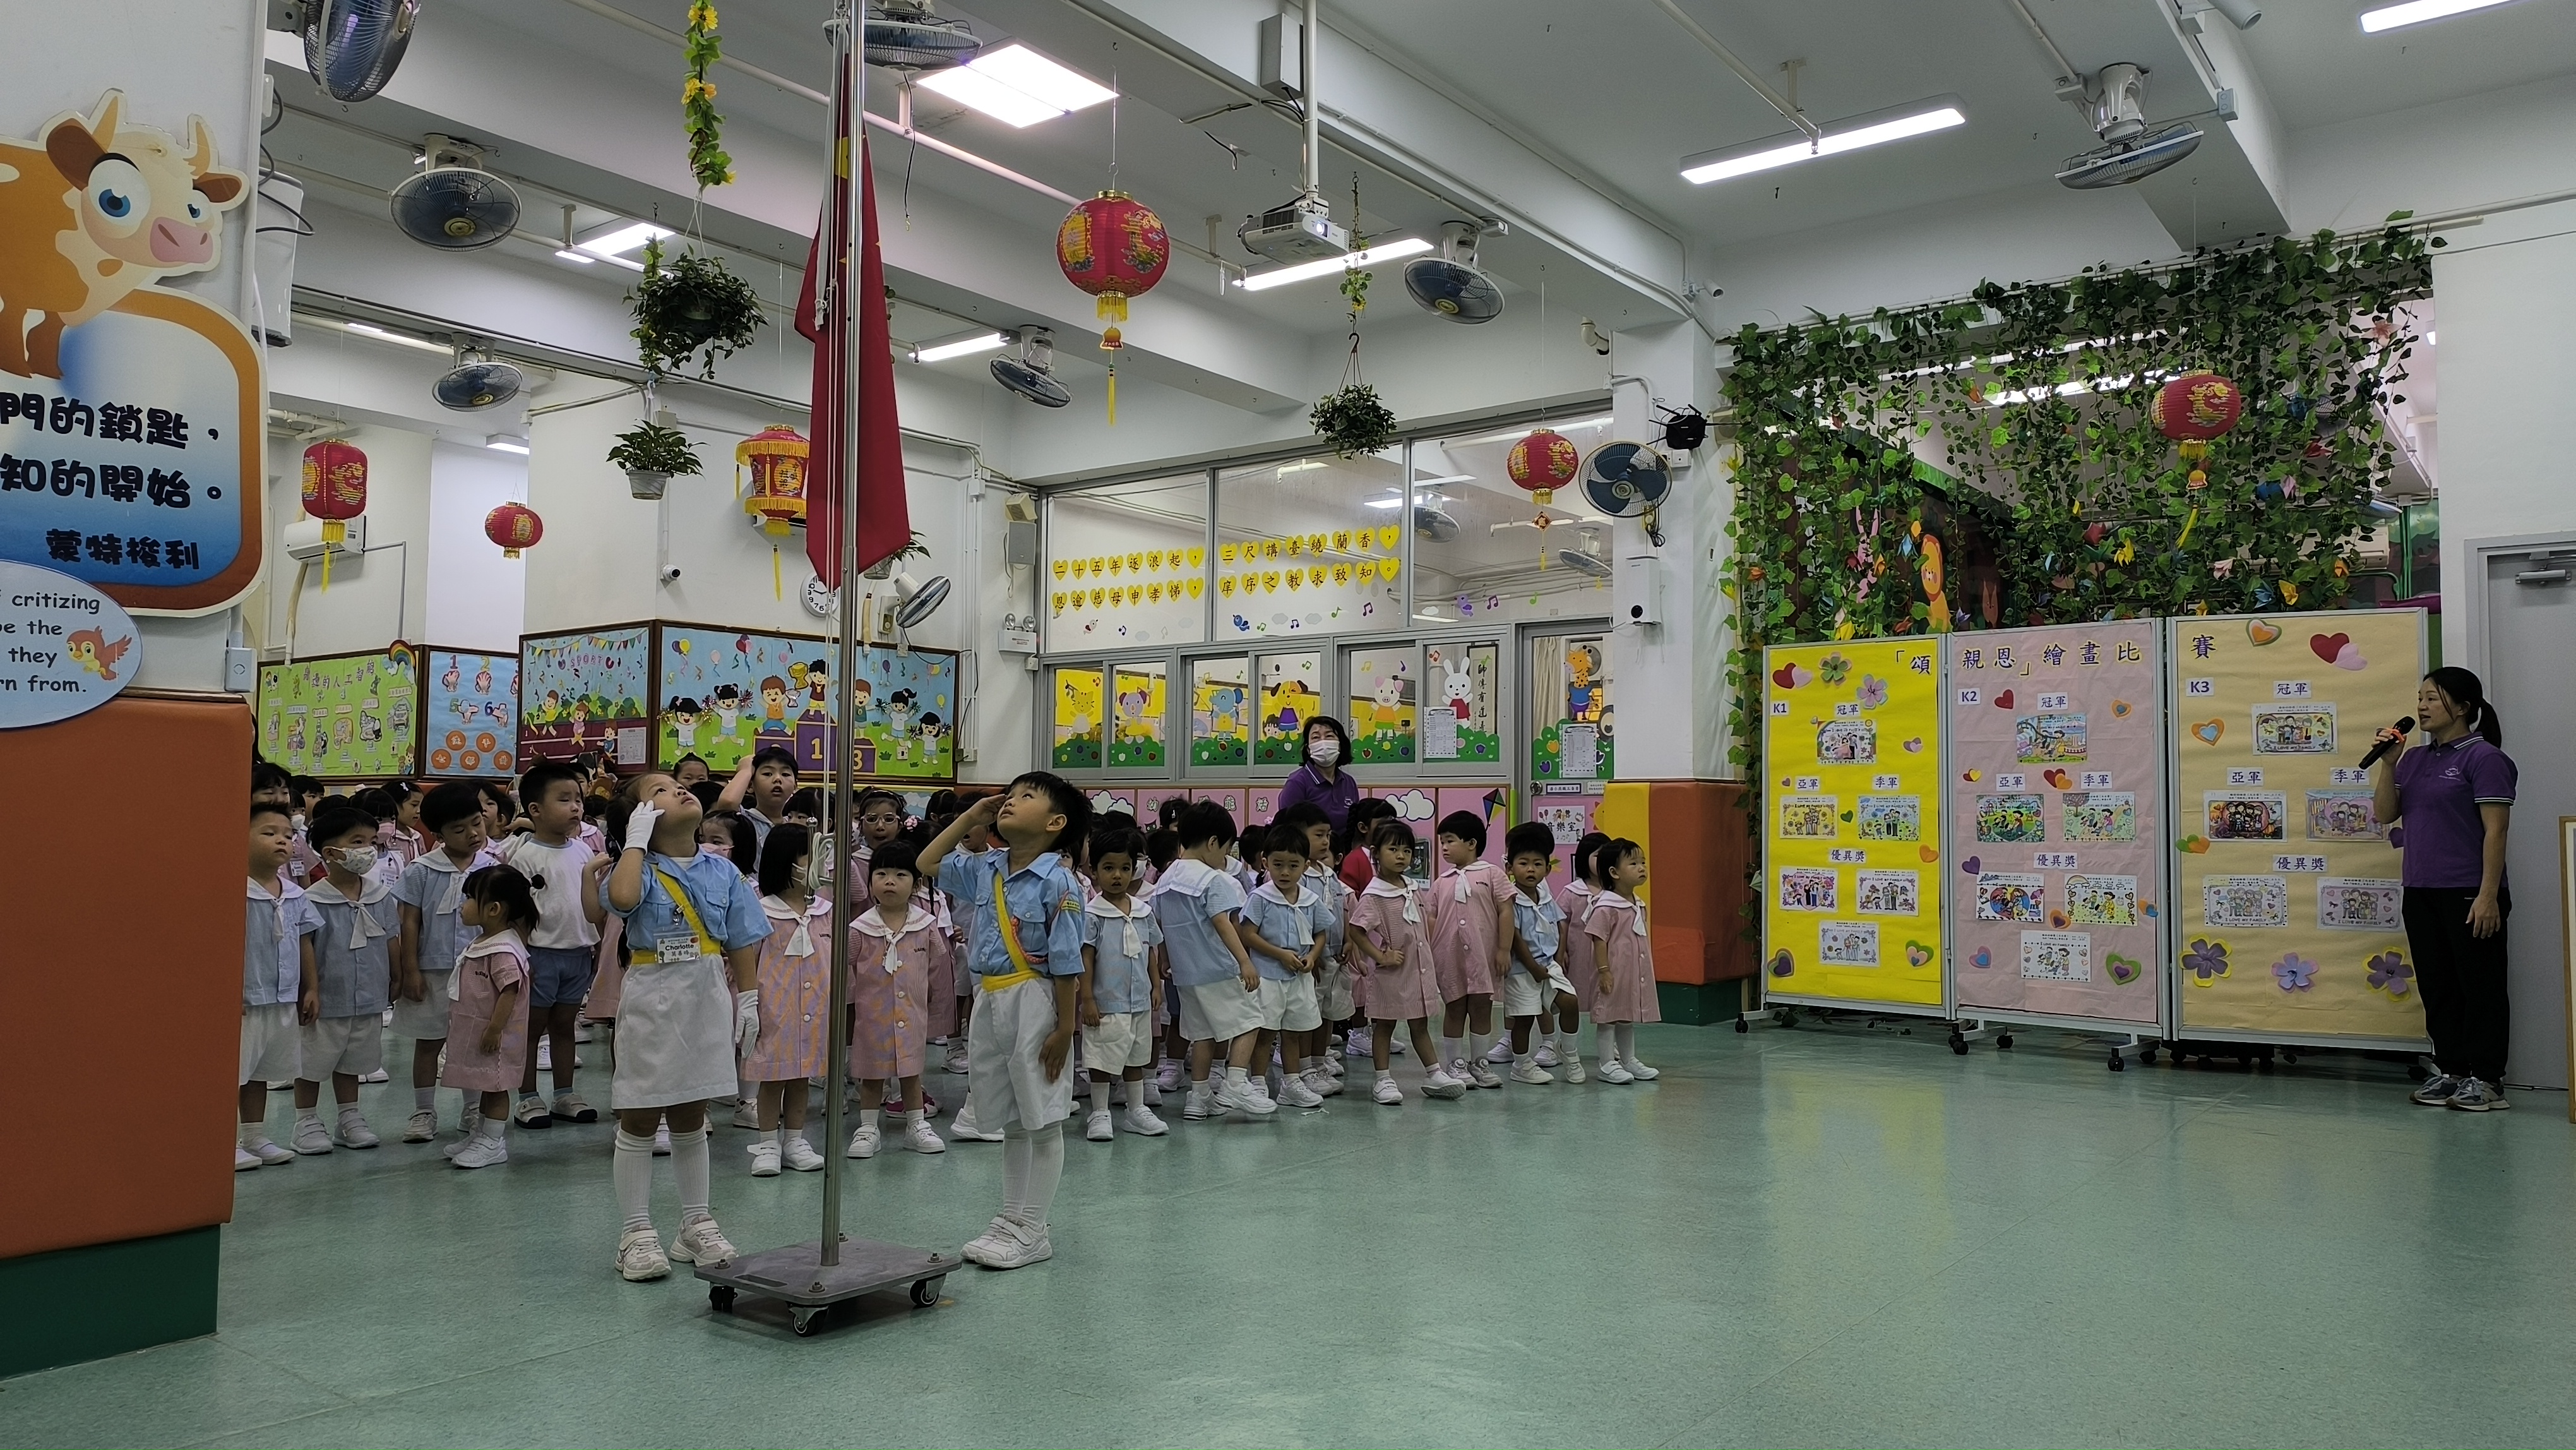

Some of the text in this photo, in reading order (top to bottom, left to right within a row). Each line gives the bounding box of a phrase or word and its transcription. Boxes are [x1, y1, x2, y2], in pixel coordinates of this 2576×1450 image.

[0, 453, 222, 508] 知的開始。
[45, 529, 200, 570] 蒙特梭利
[12, 592, 100, 614] critizing
[27, 619, 63, 635] the
[2191, 634, 2217, 659] 賽
[8, 646, 57, 668] they
[450, 654, 458, 669] 1
[480, 656, 491, 671] 2
[570, 653, 603, 669] SPORT
[27, 674, 86, 692] from.
[2190, 681, 2210, 693] K3
[2276, 683, 2308, 696] 冠軍
[1961, 691, 1977, 702] K2
[2041, 695, 2066, 708] 冠軍
[449, 698, 459, 712] 5
[484, 701, 494, 716] 6
[1773, 703, 1787, 714] K1
[811, 738, 823, 760] 1
[1999, 776, 2024, 788] 亞軍
[2083, 774, 2109, 786] 季軍
[2231, 771, 2262, 784] 亞軍
[2334, 769, 2366, 782] 季軍
